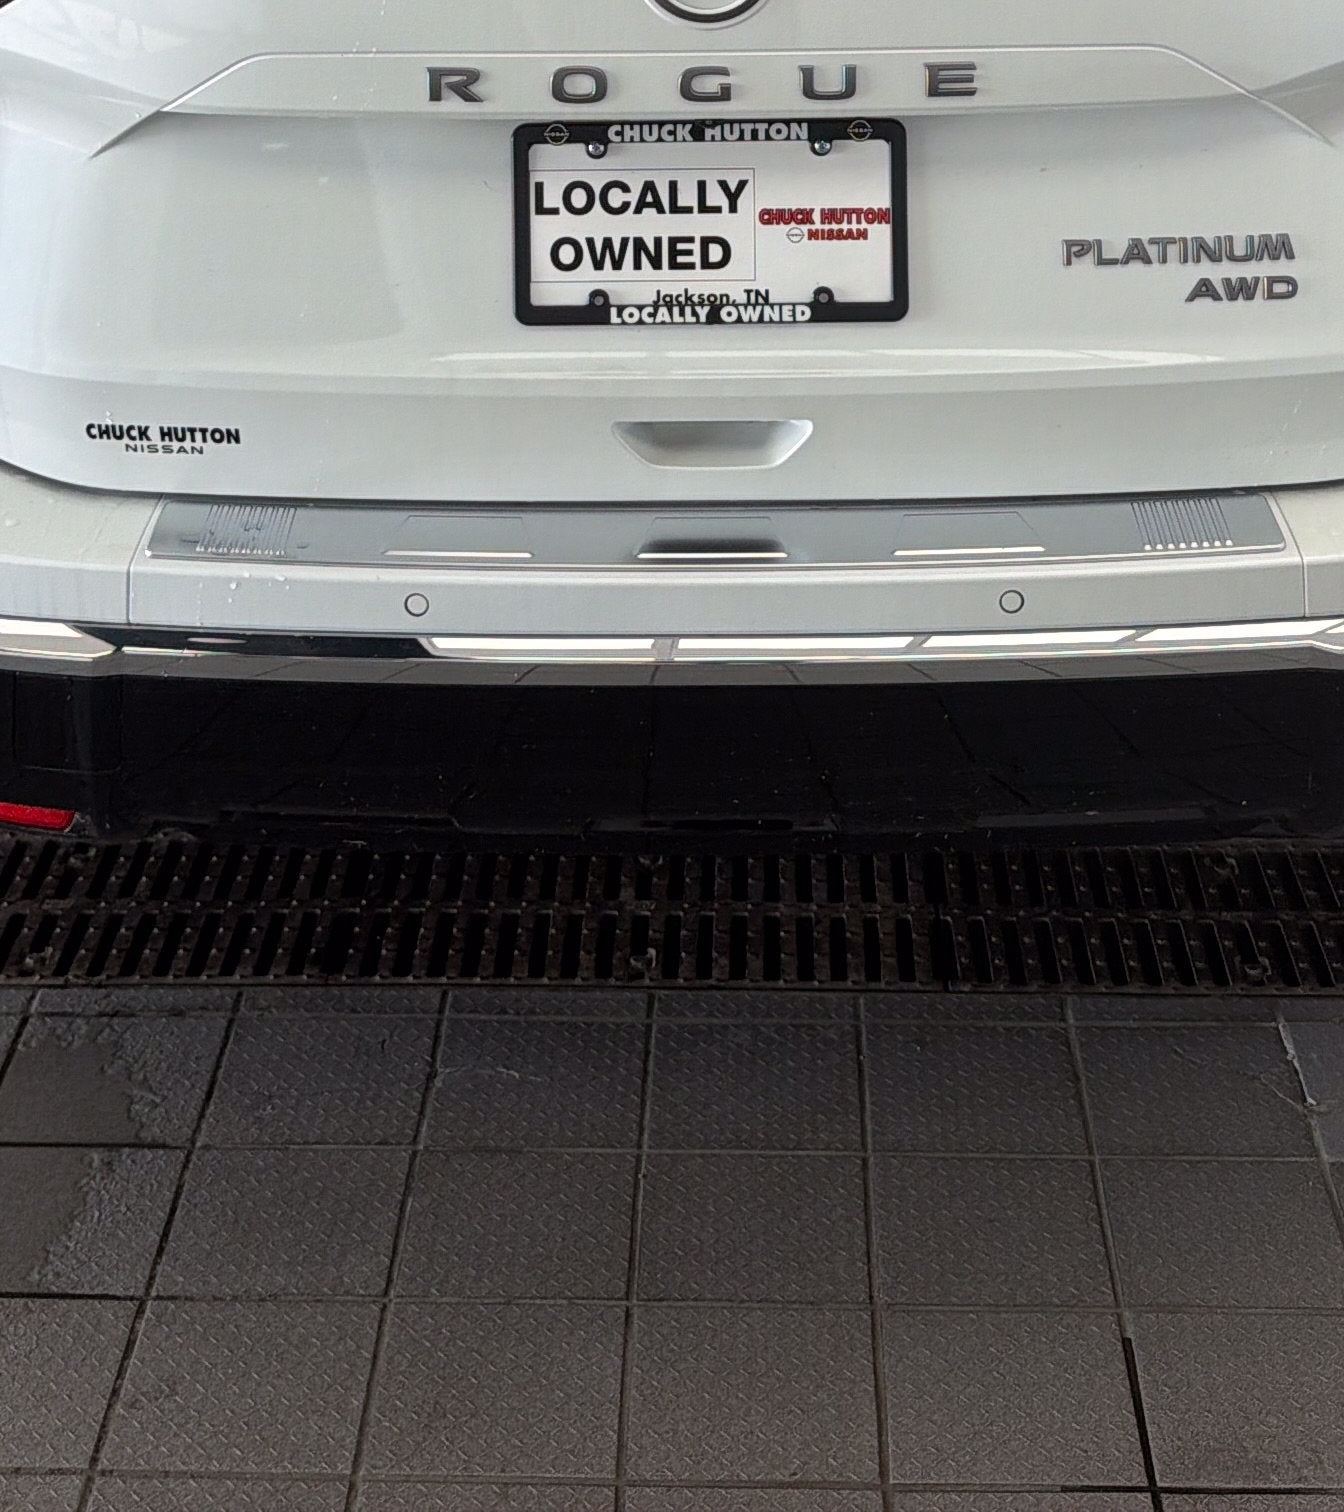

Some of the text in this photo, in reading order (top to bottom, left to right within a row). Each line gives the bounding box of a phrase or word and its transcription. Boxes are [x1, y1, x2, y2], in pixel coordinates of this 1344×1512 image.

[426, 61, 979, 103] ROGUE
[607, 122, 809, 142] CHUCK HUTTON
[534, 179, 750, 216] LOCALLY
[758, 207, 891, 225] CHUCK HUTTON
[807, 228, 869, 241] NISSAN
[550, 235, 732, 272] OWNED
[1061, 233, 1296, 266] PLATINUM
[652, 288, 770, 305] Jackson, TN
[1184, 275, 1299, 303] AWD
[609, 304, 812, 324] LOCALLY OWNED
[85, 423, 241, 444] CHUCK HUTTON
[125, 444, 204, 455] NISSAN
